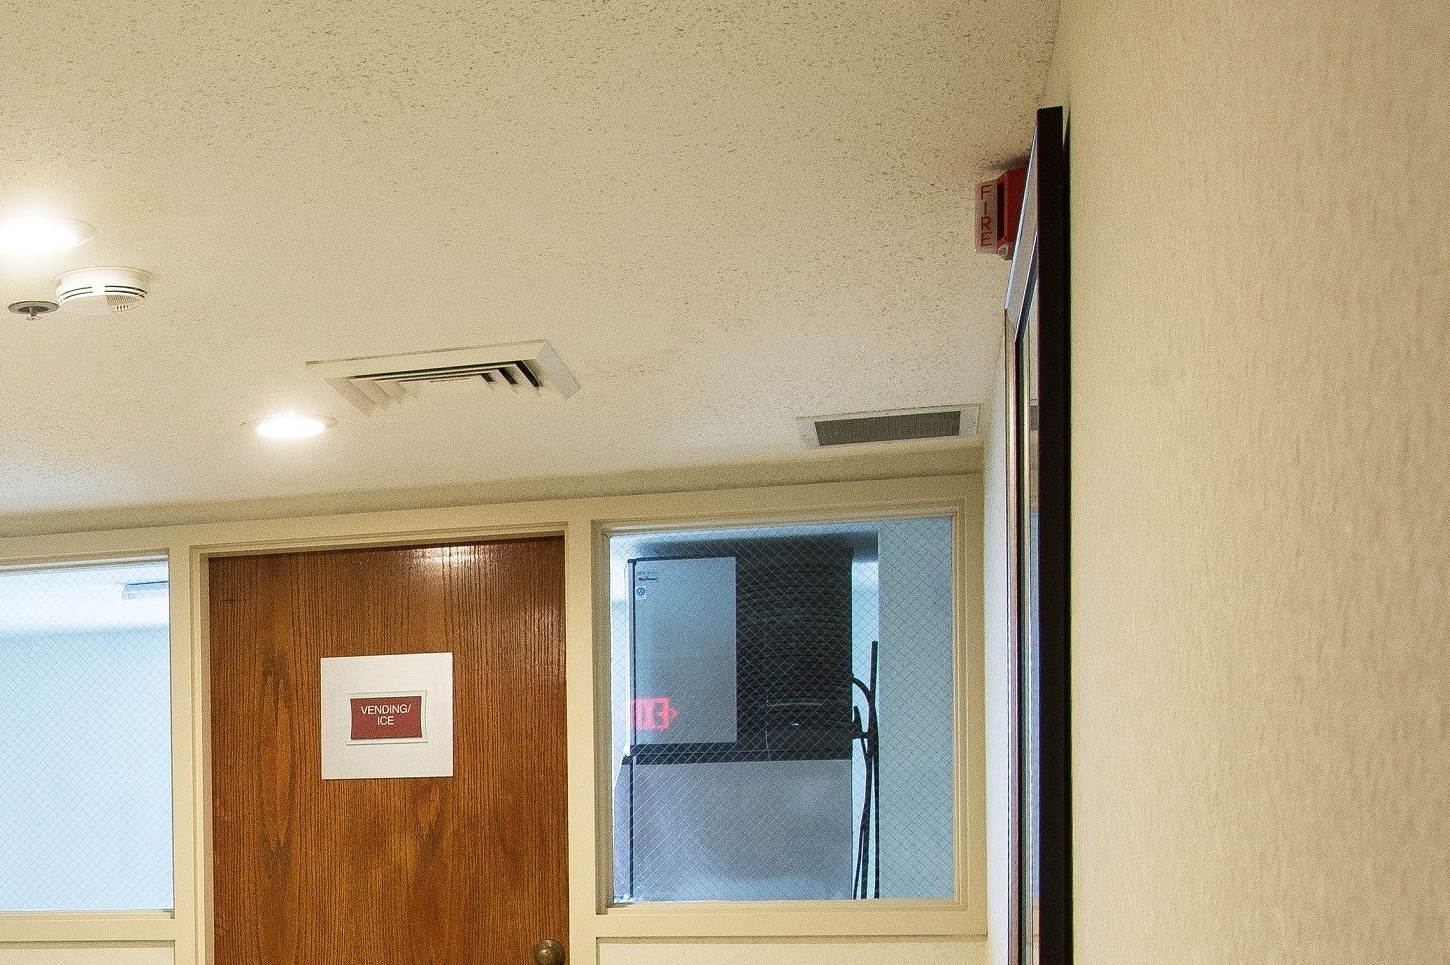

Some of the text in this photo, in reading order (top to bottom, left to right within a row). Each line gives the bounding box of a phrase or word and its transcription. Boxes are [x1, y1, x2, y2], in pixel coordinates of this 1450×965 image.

[980, 184, 993, 247] FIRE
[360, 703, 411, 715] VENDING/
[377, 716, 394, 726] ICE
